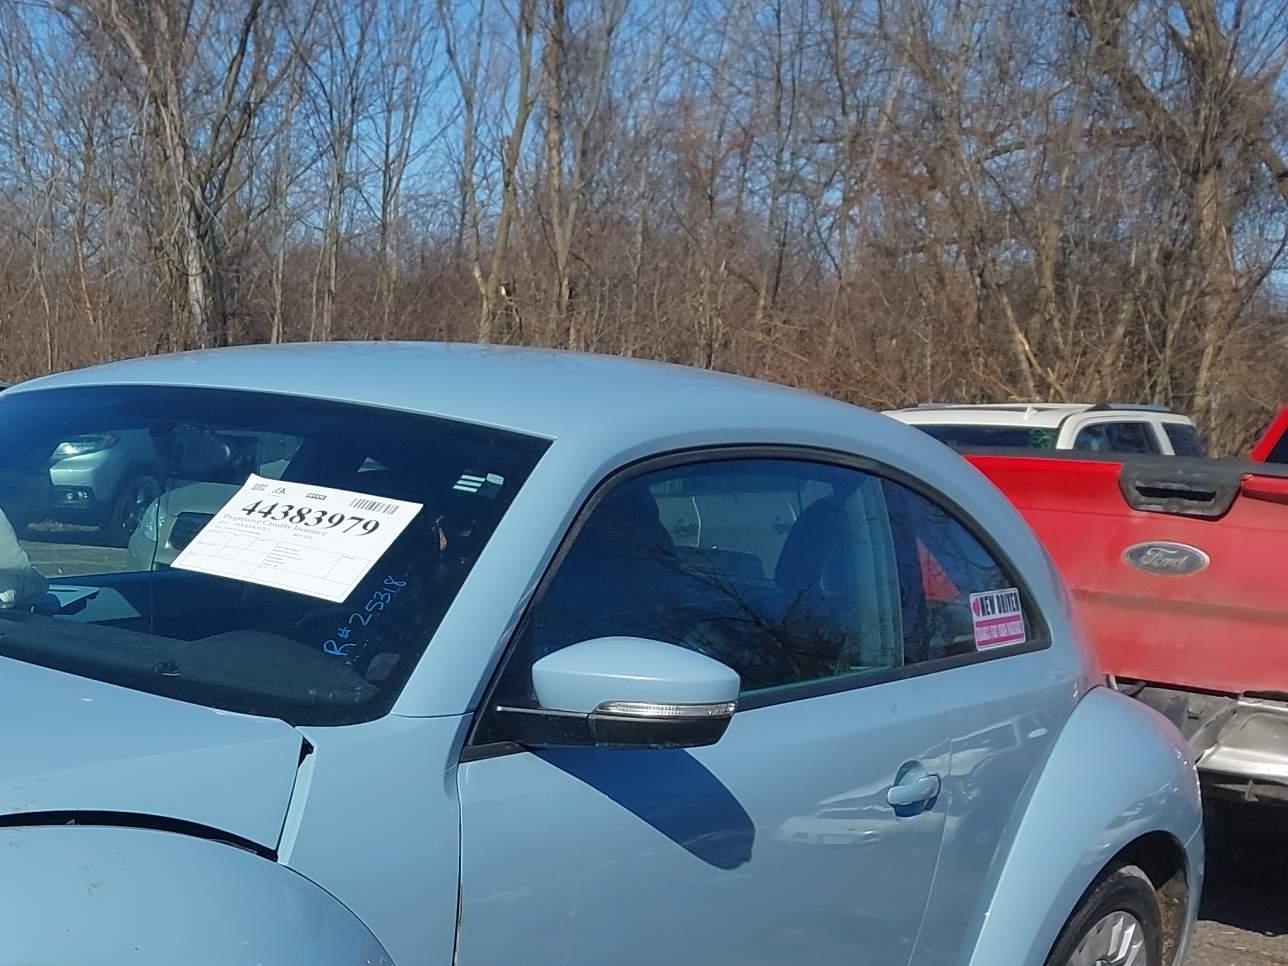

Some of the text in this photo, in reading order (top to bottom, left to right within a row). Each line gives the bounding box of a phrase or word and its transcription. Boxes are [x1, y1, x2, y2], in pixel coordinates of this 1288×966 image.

[242, 500, 380, 536] 44383979
[1140, 546, 1190, 571] Ford
[980, 592, 1020, 617] NEW DRIVER
